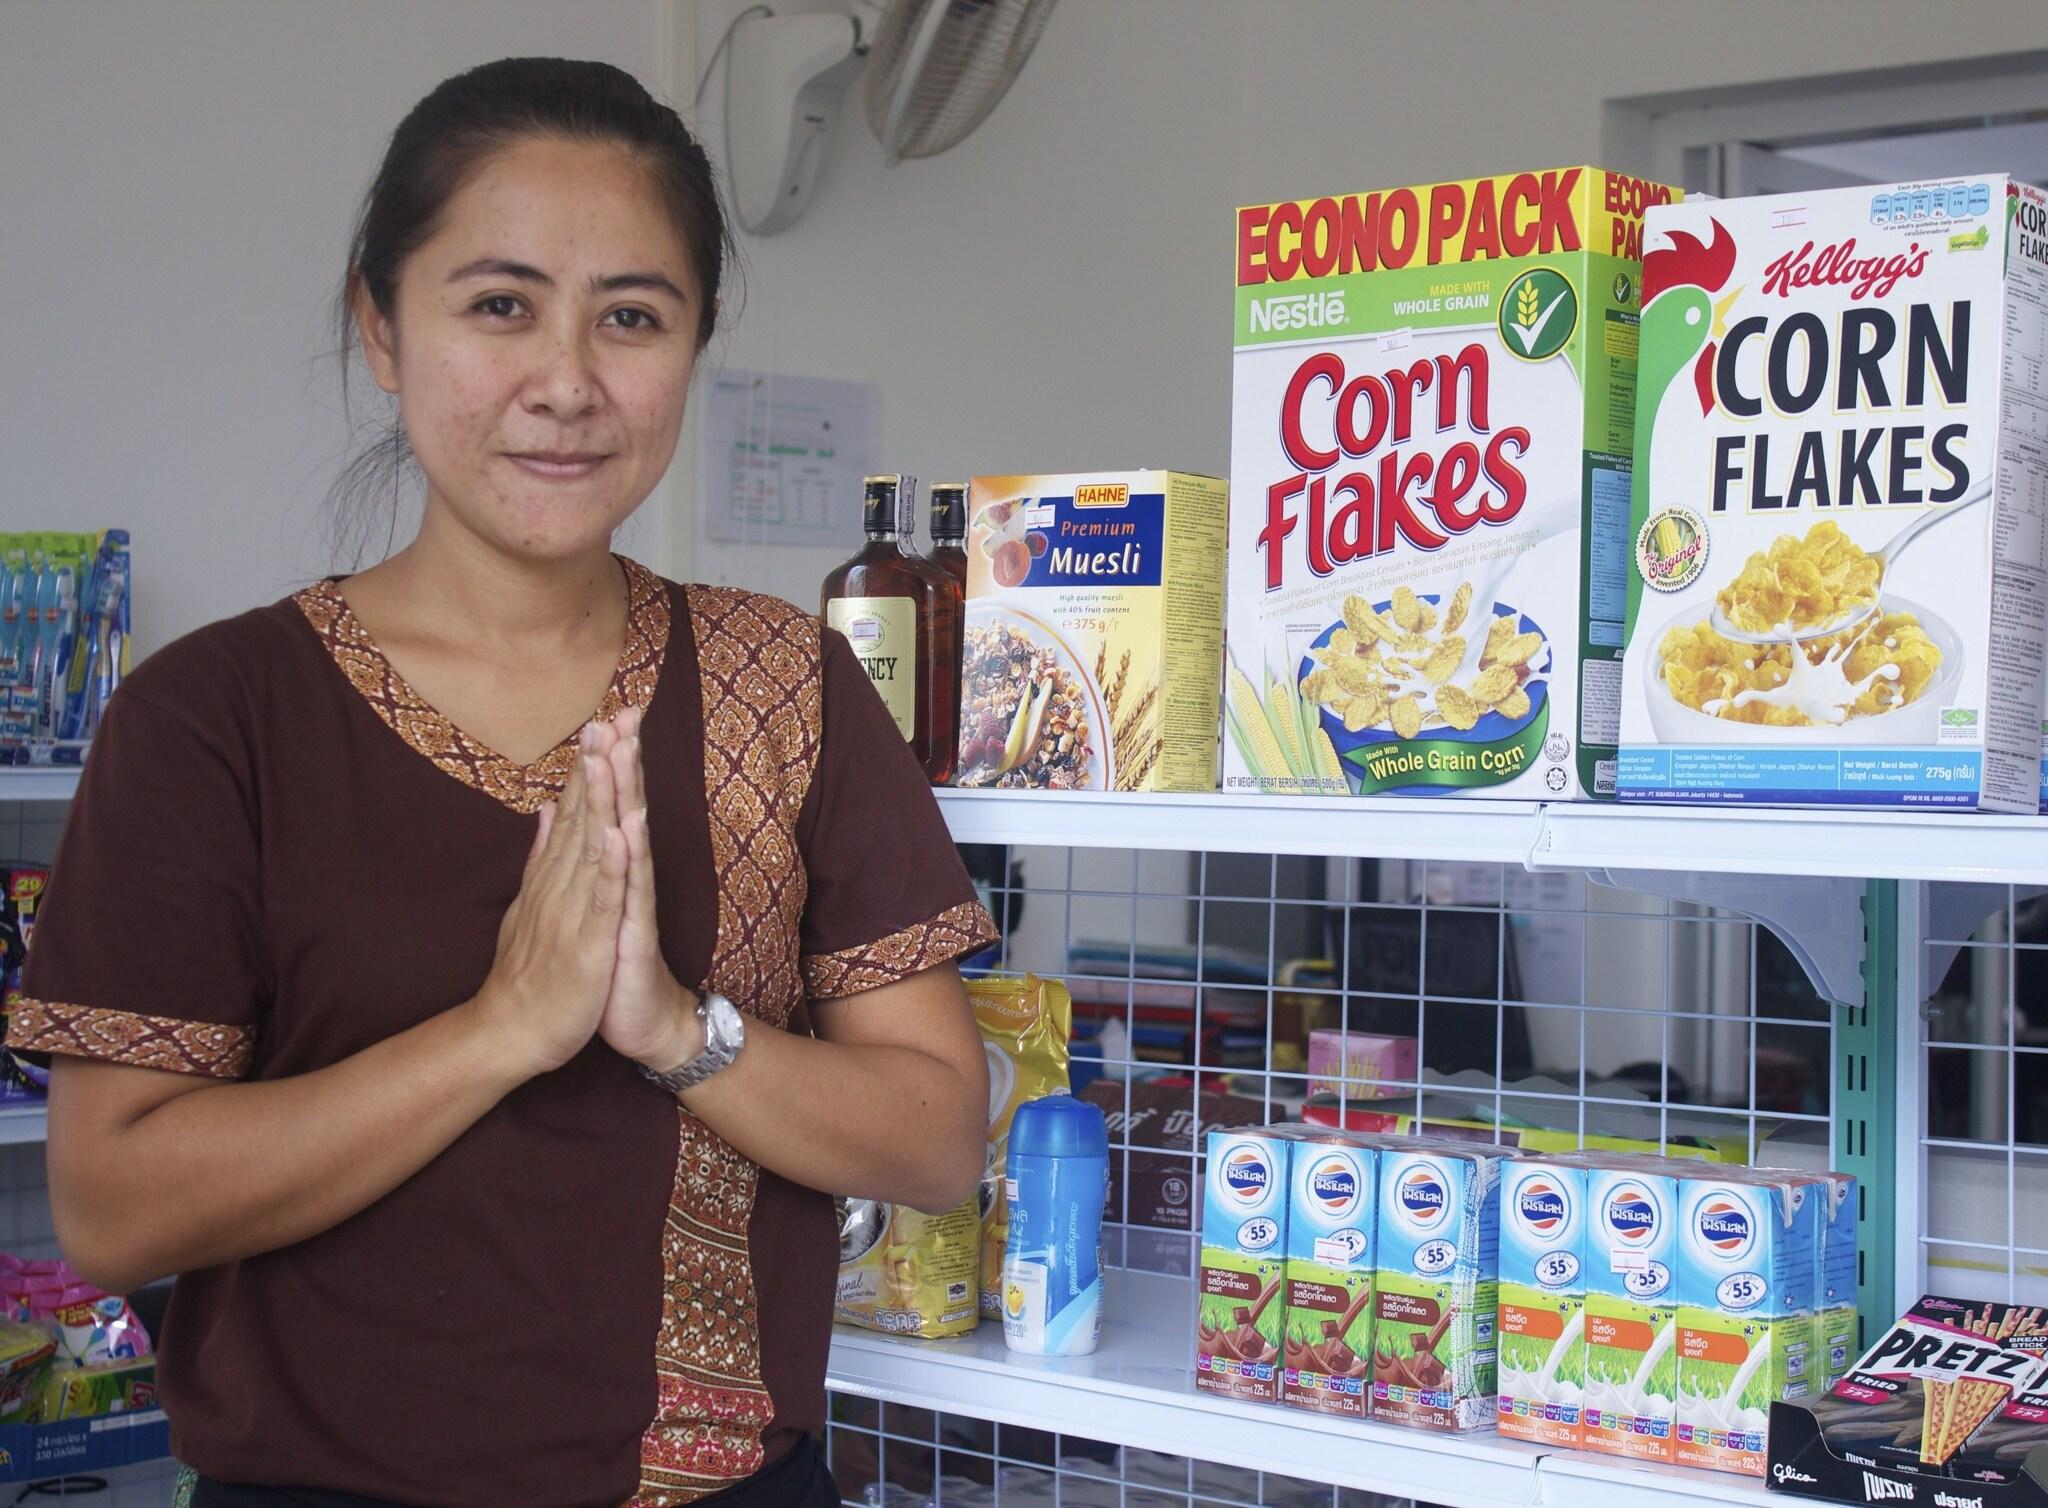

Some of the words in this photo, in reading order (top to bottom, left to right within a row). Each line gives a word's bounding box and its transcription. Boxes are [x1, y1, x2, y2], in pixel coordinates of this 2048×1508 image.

[1238, 188, 1420, 286] ECONO
[1427, 168, 1584, 266] PACK
[1762, 237, 1929, 300] Kellogg's
[1429, 283, 1460, 296] MADE
[1462, 280, 1490, 293] WITH
[1250, 290, 1346, 333] Nestlé
[1393, 298, 1441, 315] WHOLE
[1445, 294, 1489, 311] GRAIN
[1714, 300, 1971, 418] CORN
[1280, 343, 1490, 475] Corn
[1711, 423, 1970, 512] FLAKES
[1077, 487, 1126, 503] HAHNE
[1257, 426, 1531, 593] Flakes
[1684, 511, 1698, 527] Corn
[1061, 518, 1136, 537] Premium
[1049, 542, 1142, 576] Muesli
[1648, 534, 1701, 579] Original
[1342, 568, 1375, 585] Breakfast
[1686, 563, 1700, 580] 1906
[1059, 594, 1075, 603] High
[1075, 594, 1099, 603] quality
[1068, 606, 1082, 614] 40%
[1103, 606, 1130, 614] content
[1073, 618, 1096, 630] 375
[860, 657, 898, 681] NCY
[1365, 749, 1383, 762] Made
[1383, 745, 1399, 756] With
[1368, 754, 1424, 781] Whole
[1427, 749, 1477, 772] Grain
[1844, 761, 1854, 769] Net
[1855, 761, 1876, 770] Weight
[1926, 766, 1951, 780] 275g
[1227, 776, 1237, 787] NET
[1238, 776, 1257, 788] WEIGHT
[1260, 777, 1277, 788] BERAT
[1278, 777, 1298, 788] BERSIH
[1251, 1224, 1266, 1240] 55
[1428, 1247, 1445, 1264] 55
[1549, 1260, 1566, 1276] 55
[1638, 1270, 1657, 1286] 55
[1732, 1281, 1752, 1298] 55
[1505, 1313, 1528, 1325] รสจืด
[1592, 1324, 1616, 1336] รสจืด
[1684, 1330, 1694, 1338] นม
[1684, 1337, 1708, 1349] รสจืด
[1858, 1328, 2030, 1380] PRETZ
[1253, 1383, 1264, 1396] 225
[1854, 1375, 1899, 1391] FRIED
[1343, 1398, 1354, 1410] 225
[1433, 1413, 1444, 1426] 225
[1559, 1428, 1570, 1440] 225
[1648, 1441, 1660, 1455] 225
[1742, 1456, 1756, 1470] 225
[1773, 1463, 1818, 1484] Glico
